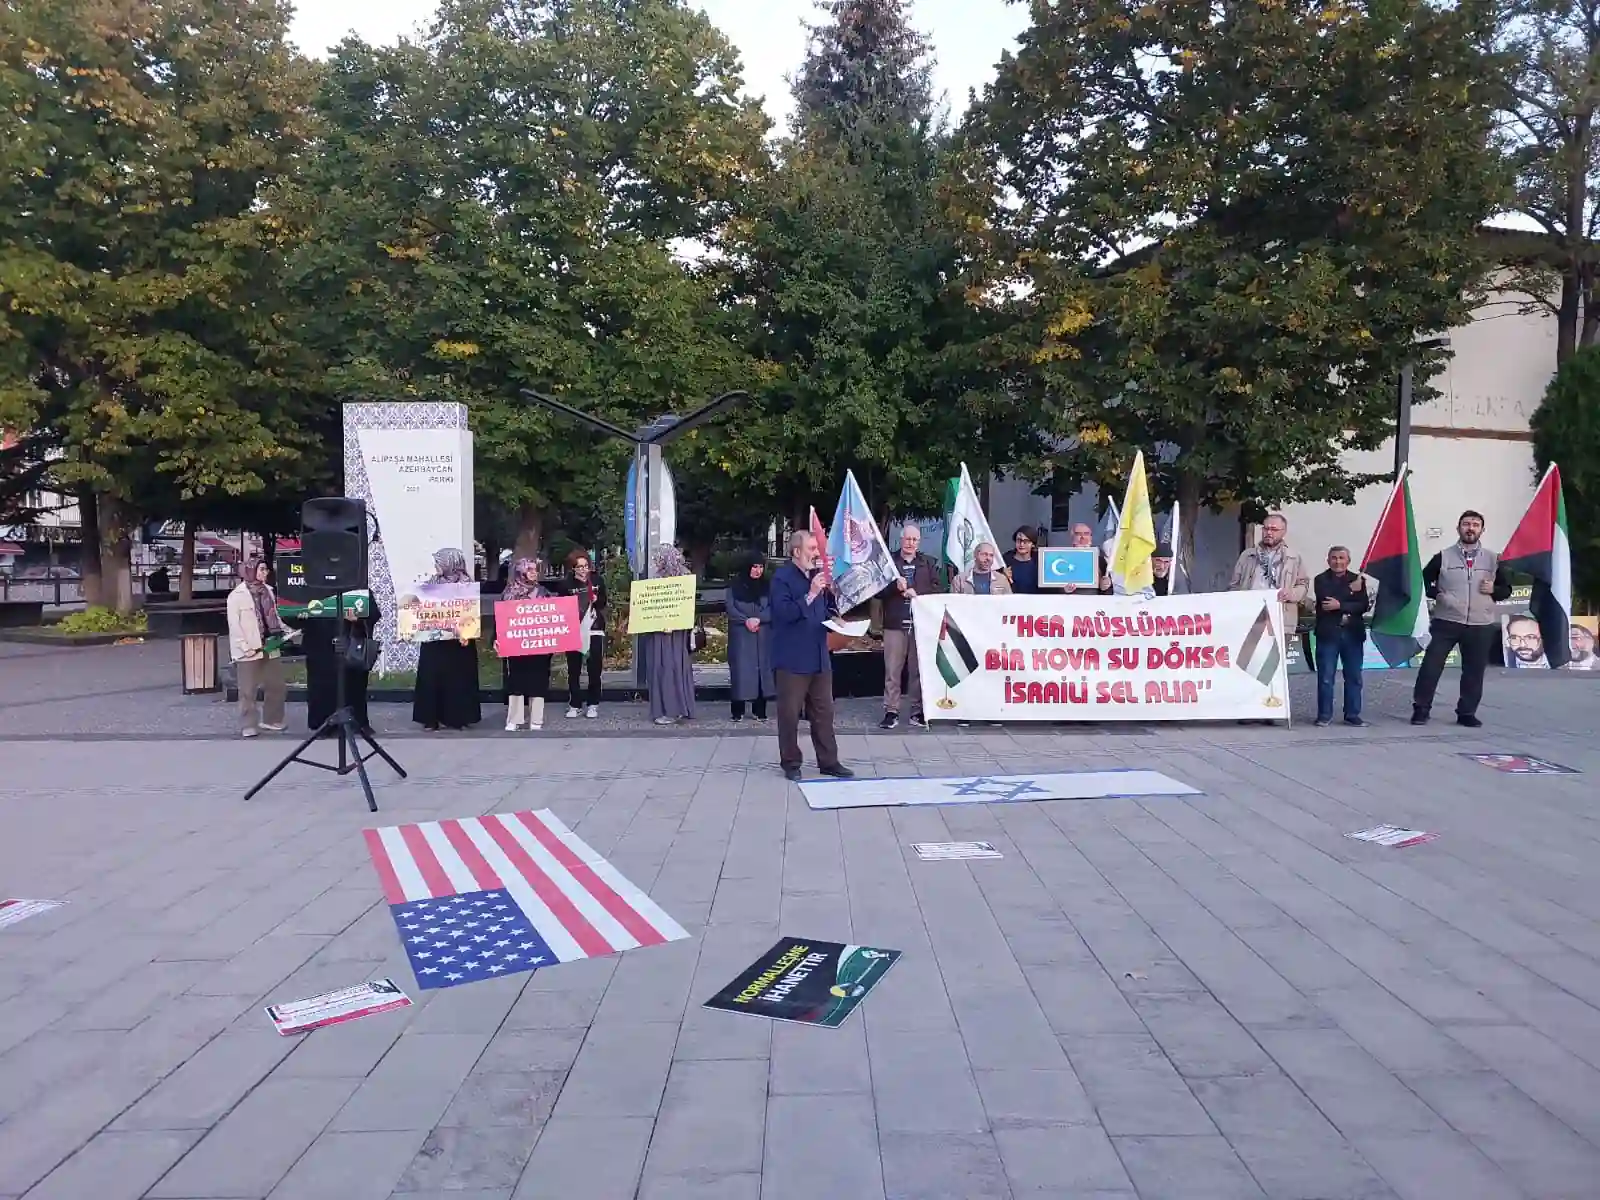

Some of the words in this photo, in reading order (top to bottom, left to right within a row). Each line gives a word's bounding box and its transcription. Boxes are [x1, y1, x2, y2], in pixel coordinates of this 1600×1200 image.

[398, 465, 453, 473] AZERBAYCAN
[1072, 611, 1212, 638] MÜSLÜMAN
[521, 638, 558, 649] ÜZERE
[985, 643, 1026, 671] BİR
[1032, 647, 1100, 671] KOVA
[1107, 648, 1139, 670] SU
[1146, 641, 1231, 670] DÖKSE
[1004, 676, 1089, 704] İSRAİLİ
[1095, 681, 1138, 704] SEL
